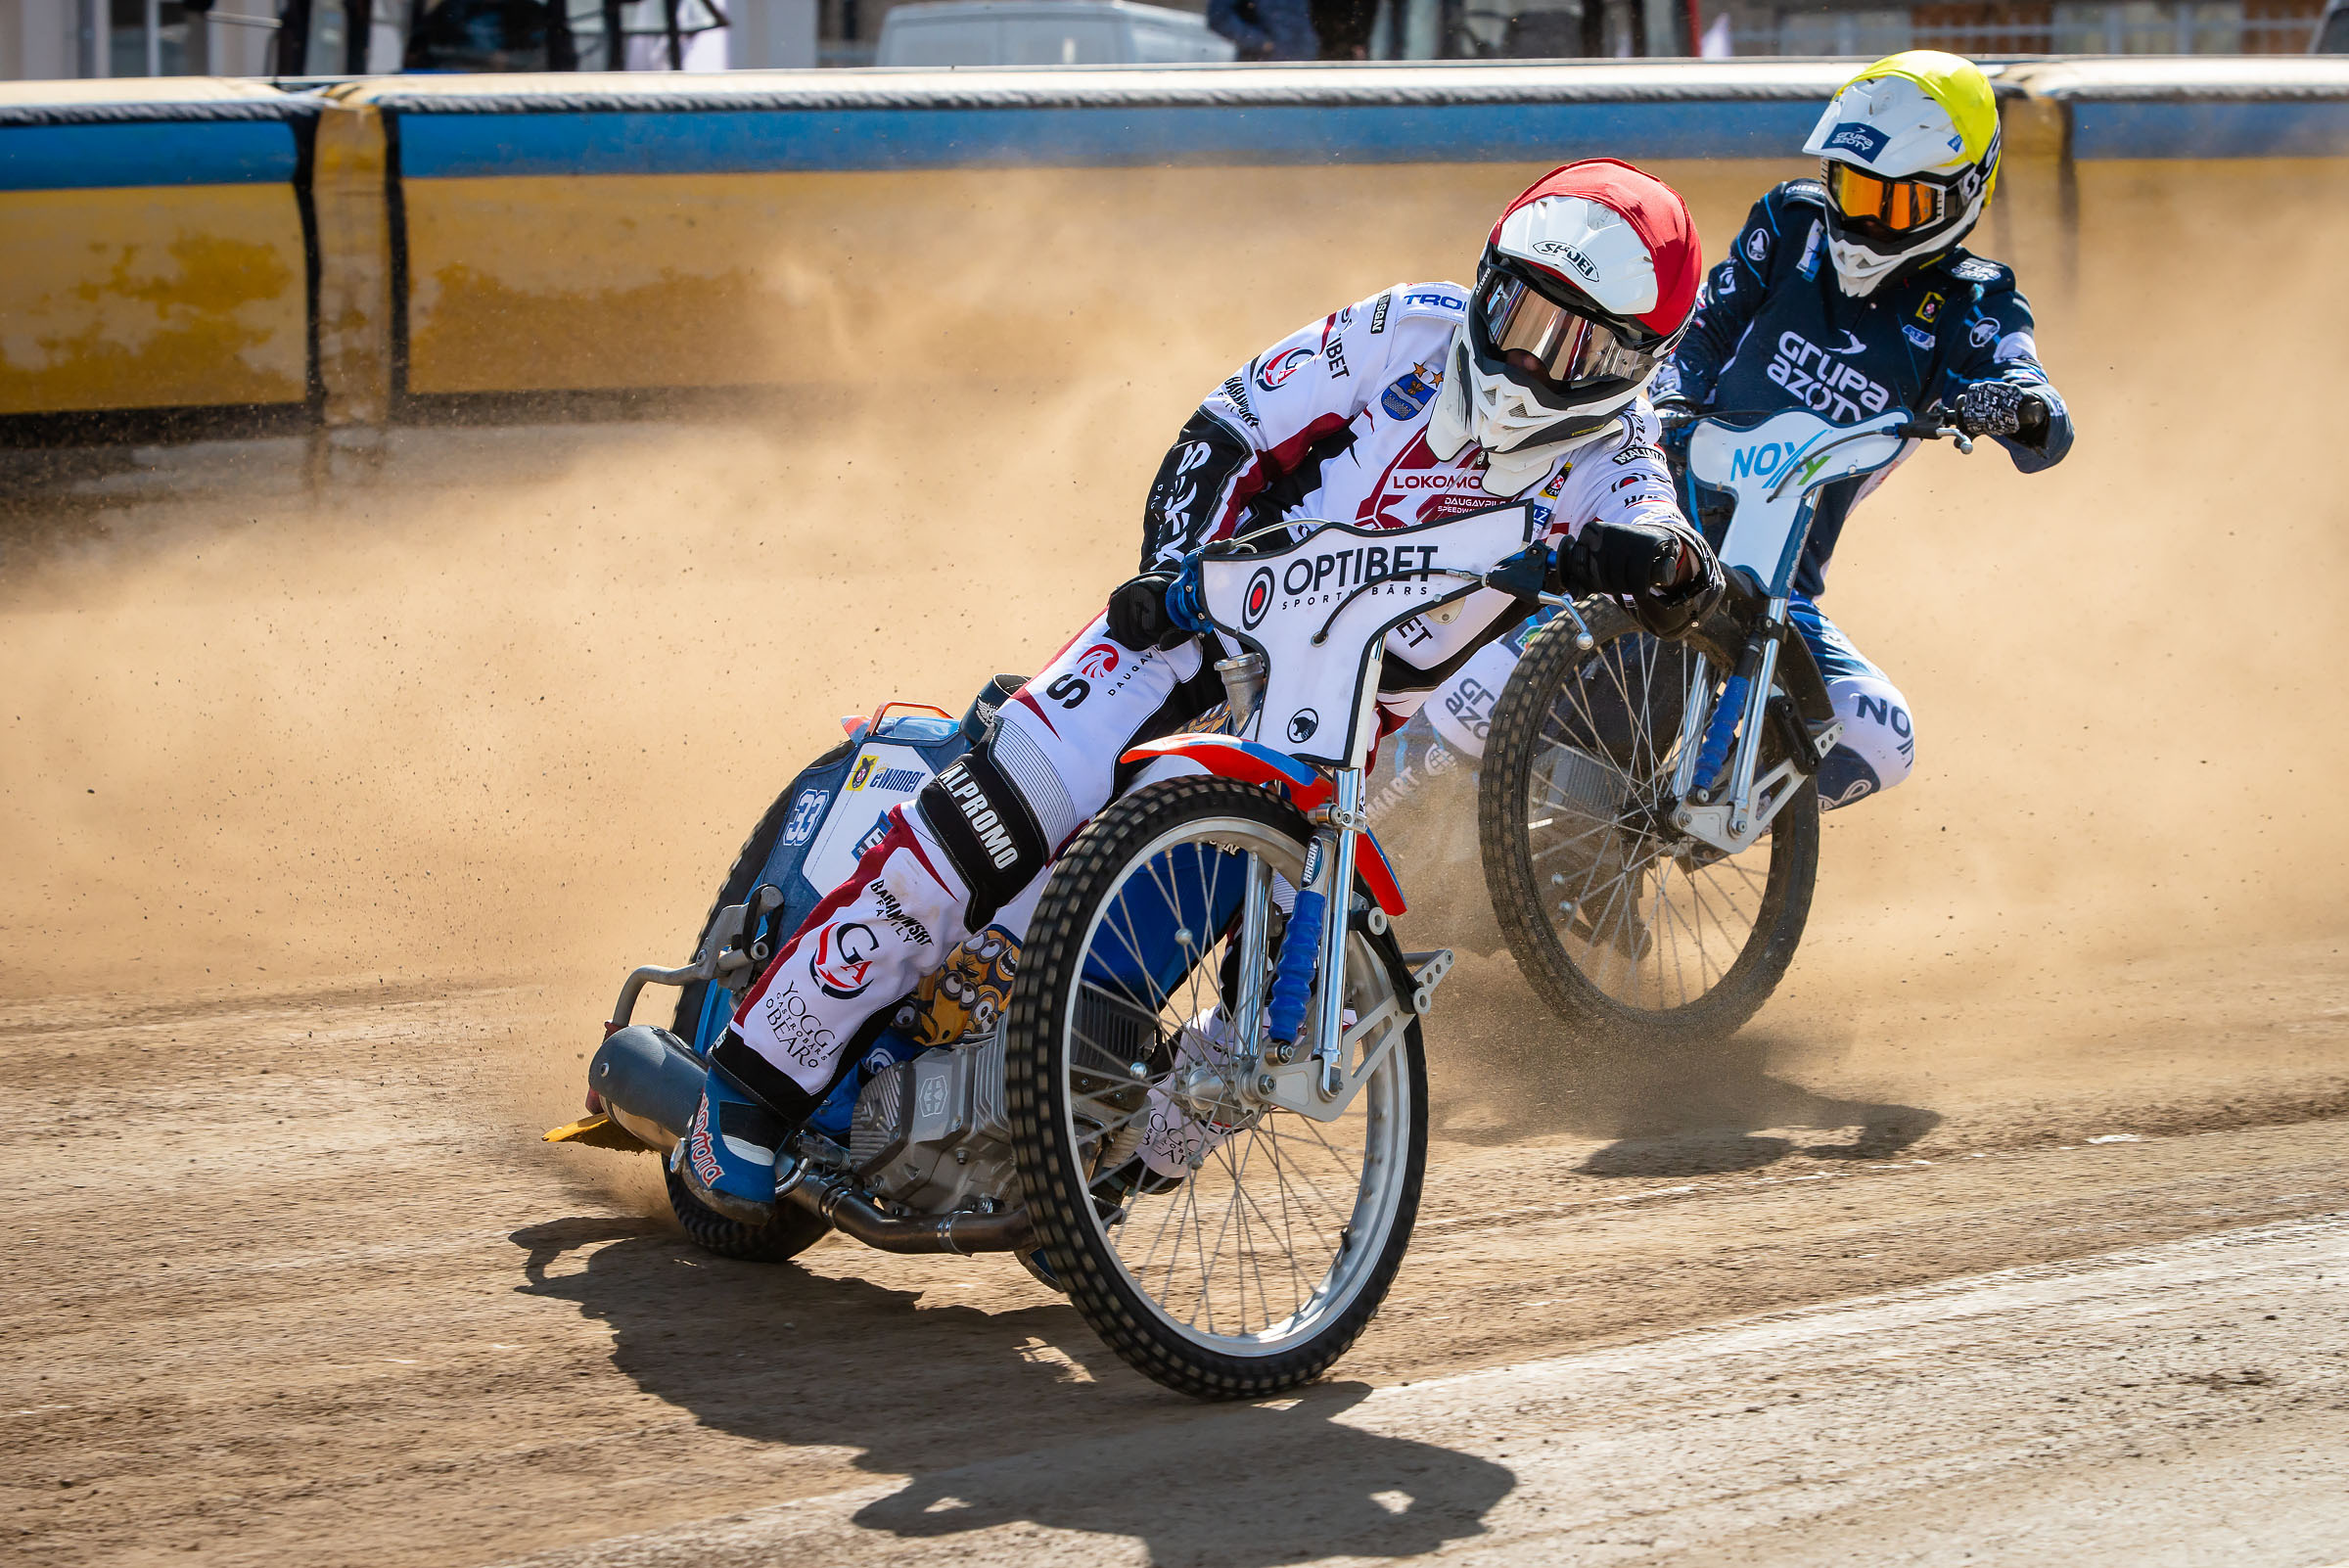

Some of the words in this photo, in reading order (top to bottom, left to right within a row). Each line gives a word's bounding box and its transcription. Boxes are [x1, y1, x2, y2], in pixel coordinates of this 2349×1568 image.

[1393, 475, 1483, 490] LOKOMO
[1283, 545, 1439, 596] OPTIBET
[1107, 646, 1161, 697] DAUGAV
[783, 788, 830, 847] 33
[938, 763, 1019, 870] ALPROMO
[783, 981, 844, 1056] YOGGI
